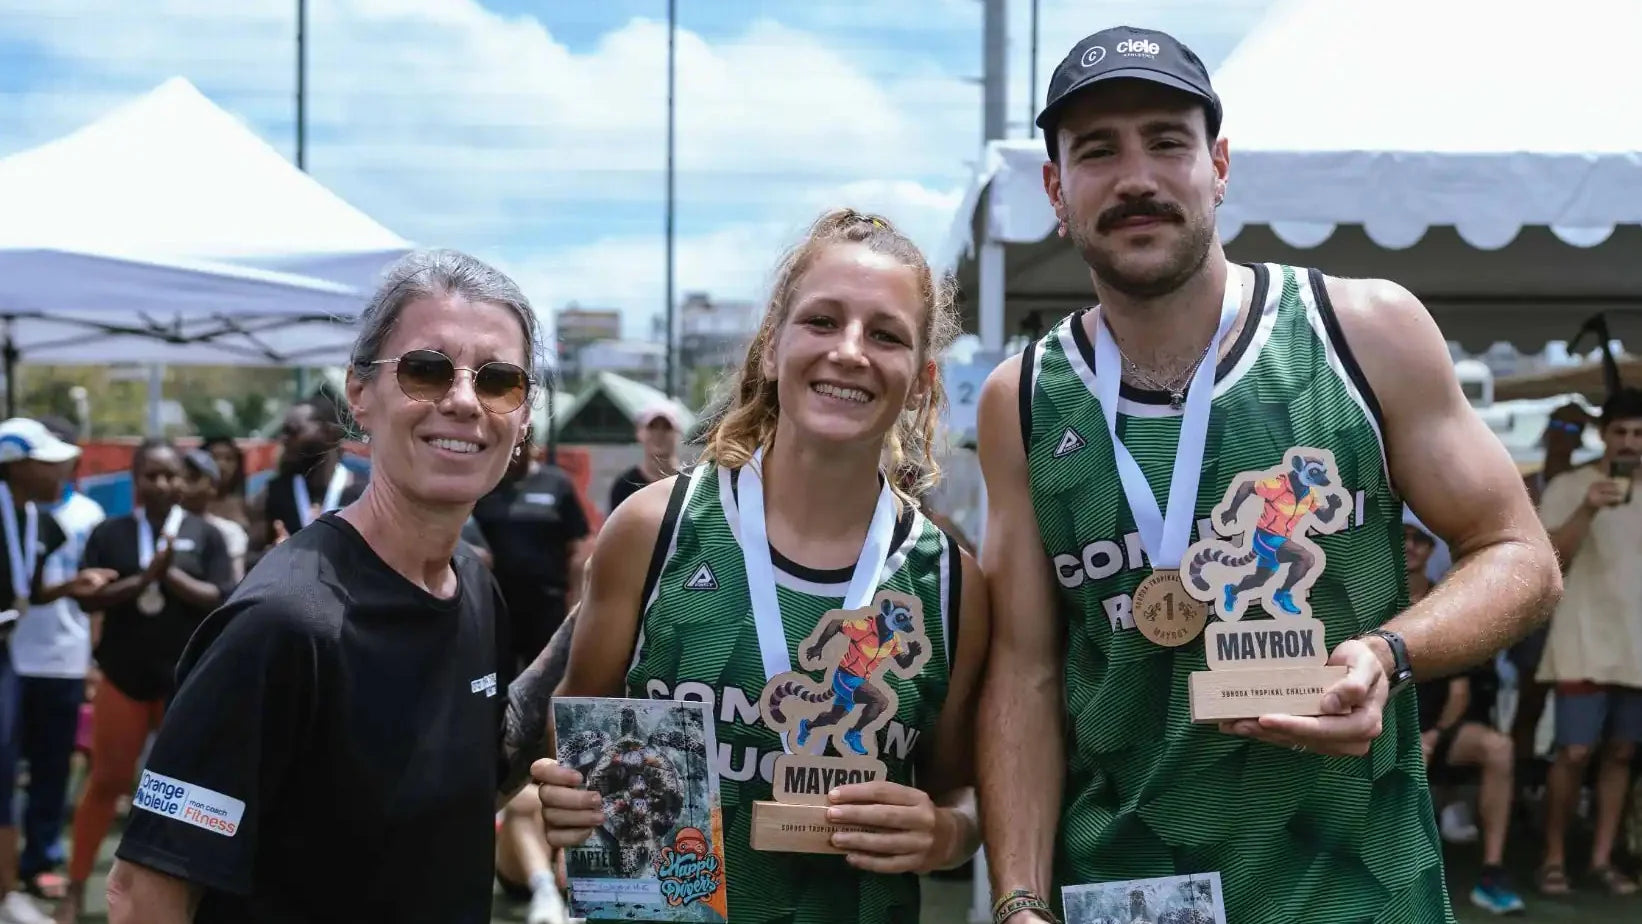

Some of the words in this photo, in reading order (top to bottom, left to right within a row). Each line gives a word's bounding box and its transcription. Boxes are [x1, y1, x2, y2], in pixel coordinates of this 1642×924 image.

[1116, 39, 1160, 55] ciele
[1163, 592, 1174, 621] 1
[1153, 627, 1188, 640] MAYROX
[1216, 629, 1316, 661] MAYROX
[143, 791, 179, 815] bleue
[189, 800, 205, 809] mon
[206, 806, 228, 816] coach
[184, 807, 236, 834] Fitness
[660, 852, 718, 878] Happy
[661, 876, 717, 901] Divers
